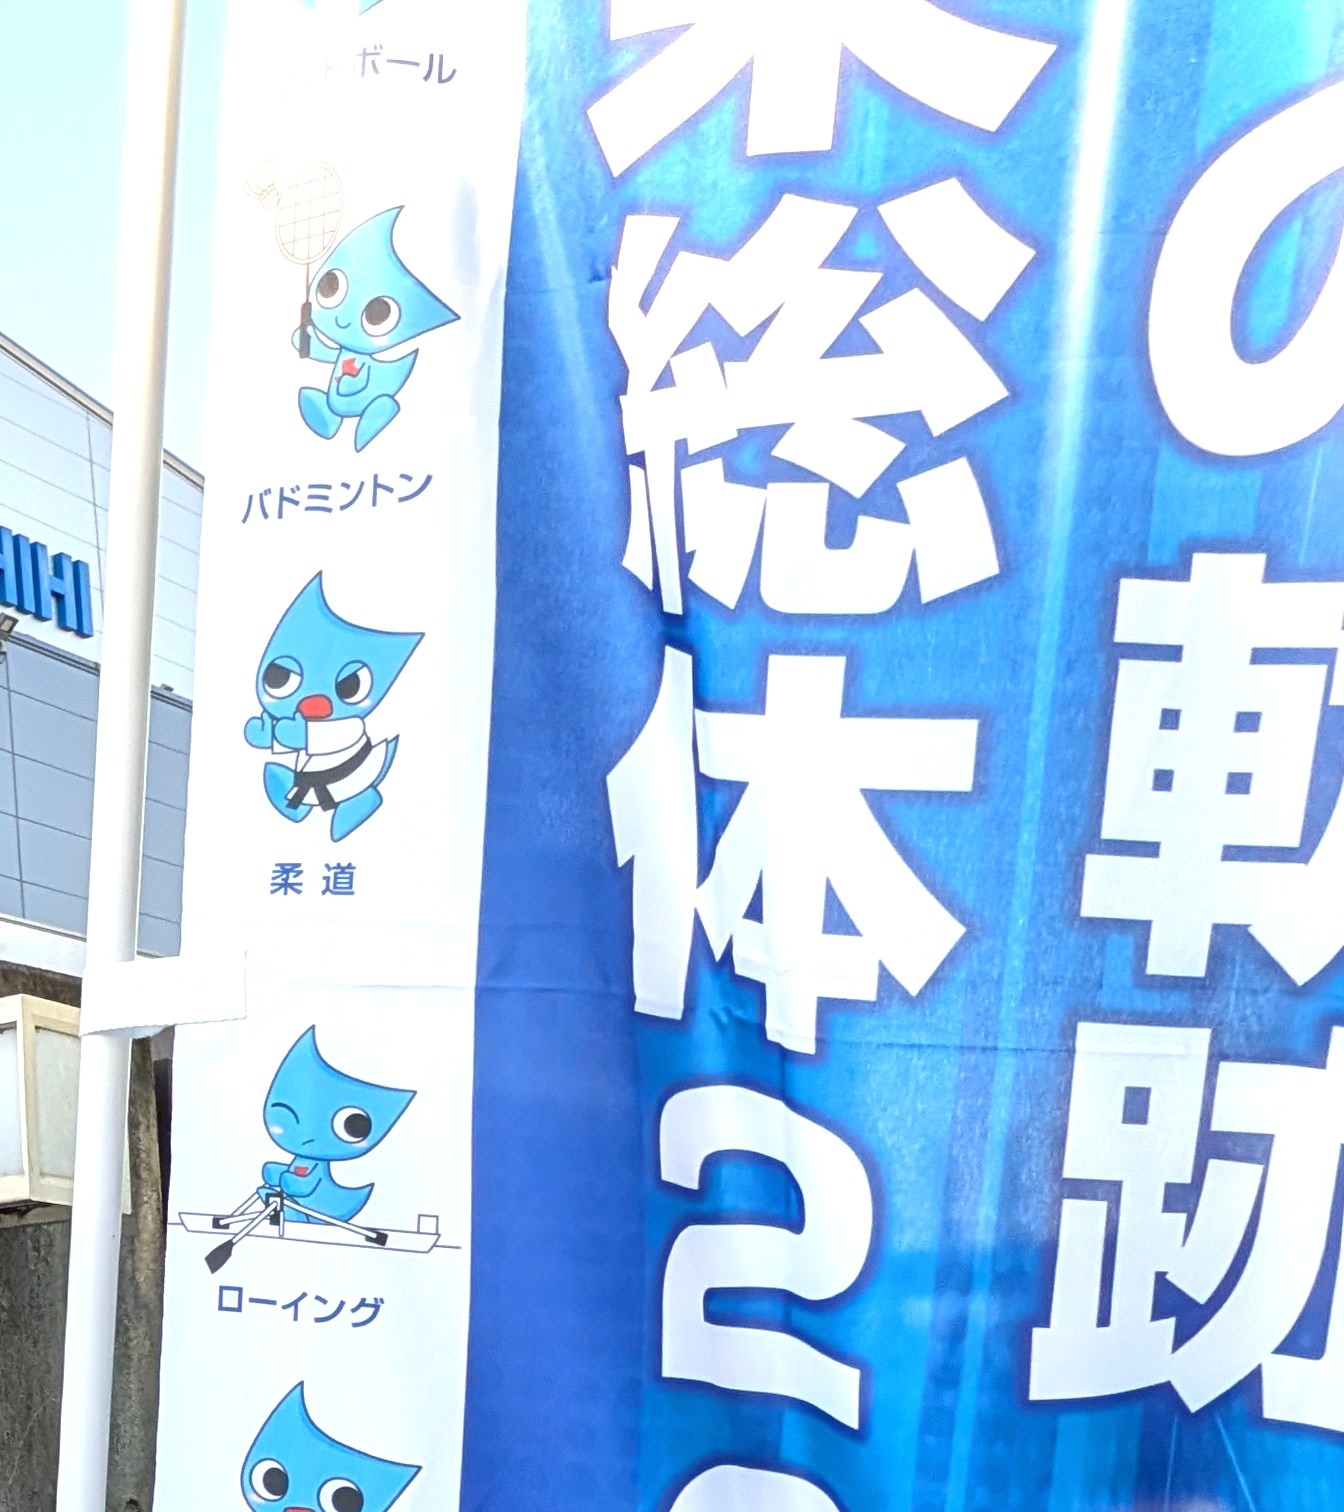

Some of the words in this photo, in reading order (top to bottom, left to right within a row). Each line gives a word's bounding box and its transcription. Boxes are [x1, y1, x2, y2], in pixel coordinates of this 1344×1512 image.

[241, 472, 434, 525] バドミントン
[269, 861, 357, 897] 柔道
[217, 1285, 385, 1328] ローイング
